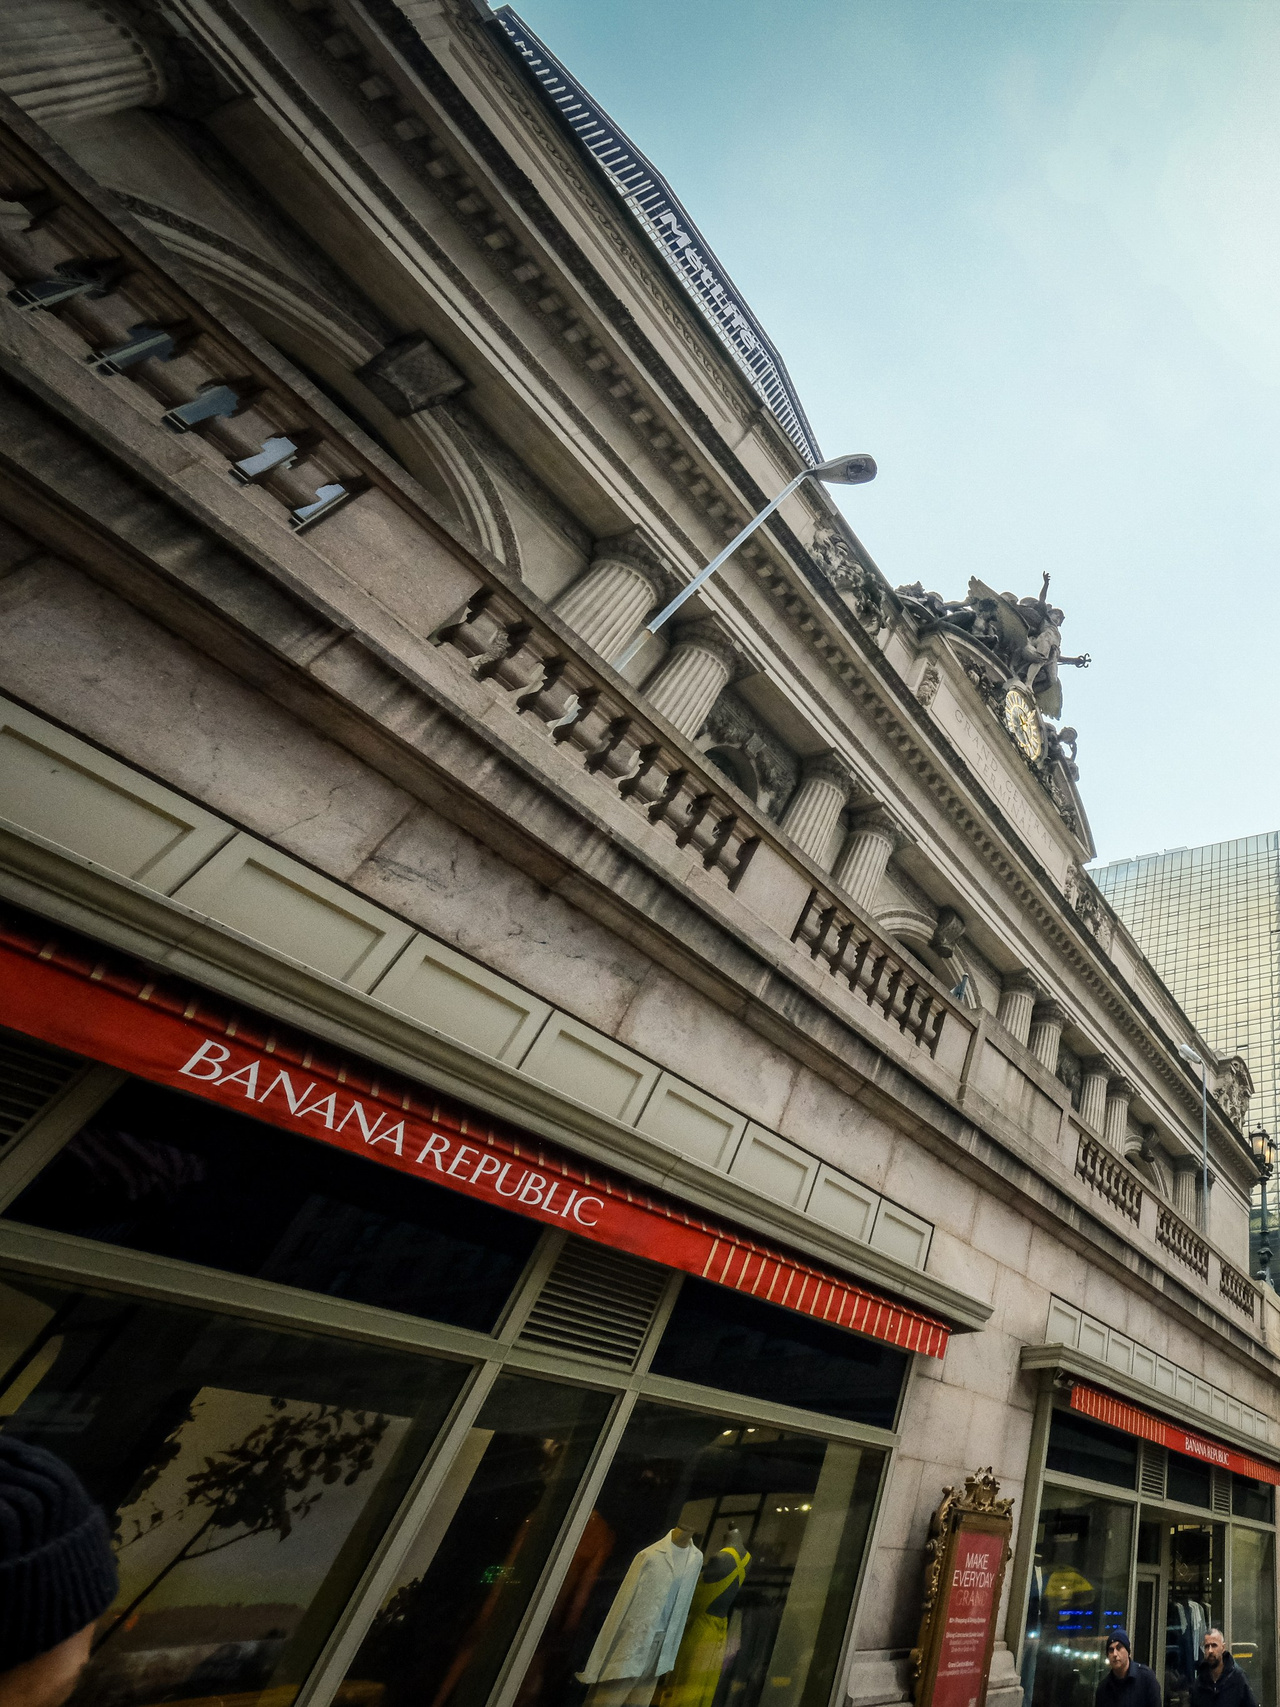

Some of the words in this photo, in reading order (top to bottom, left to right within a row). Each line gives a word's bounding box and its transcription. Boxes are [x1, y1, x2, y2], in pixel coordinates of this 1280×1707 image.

[660, 212, 755, 350] MetLife
[954, 709, 998, 773] GRAND
[1005, 779, 1054, 852] CENTRAL
[976, 752, 1033, 838] TERMINAL
[178, 1038, 404, 1156] BANANA
[415, 1132, 604, 1227] REPUBLIC
[1185, 1436, 1207, 1457] BANANA
[1206, 1445, 1230, 1466] REPUBLIC
[952, 1570, 995, 1588] EVERYDAY
[965, 1552, 990, 1570] MAKE
[955, 1589, 989, 1607] GRAND
